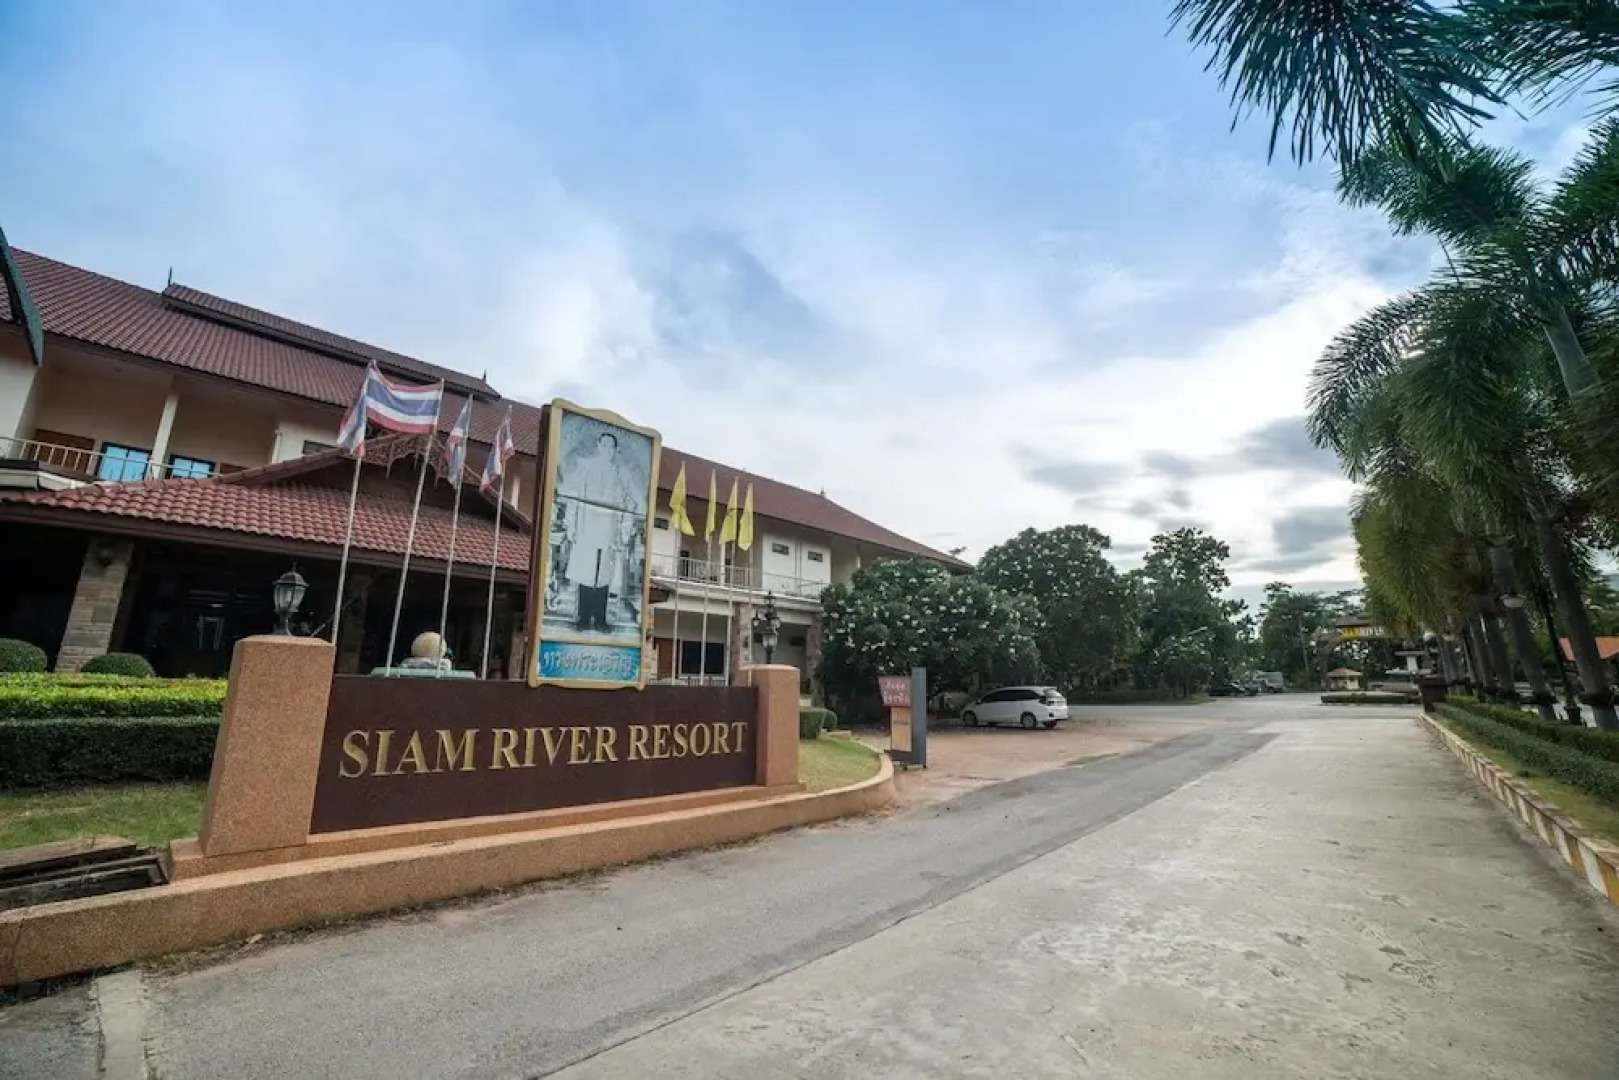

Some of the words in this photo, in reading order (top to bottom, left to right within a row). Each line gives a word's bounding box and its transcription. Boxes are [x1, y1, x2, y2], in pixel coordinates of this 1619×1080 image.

[339, 728, 480, 778] SIAM
[488, 725, 618, 769] RIVER
[627, 721, 748, 760] RESORT
